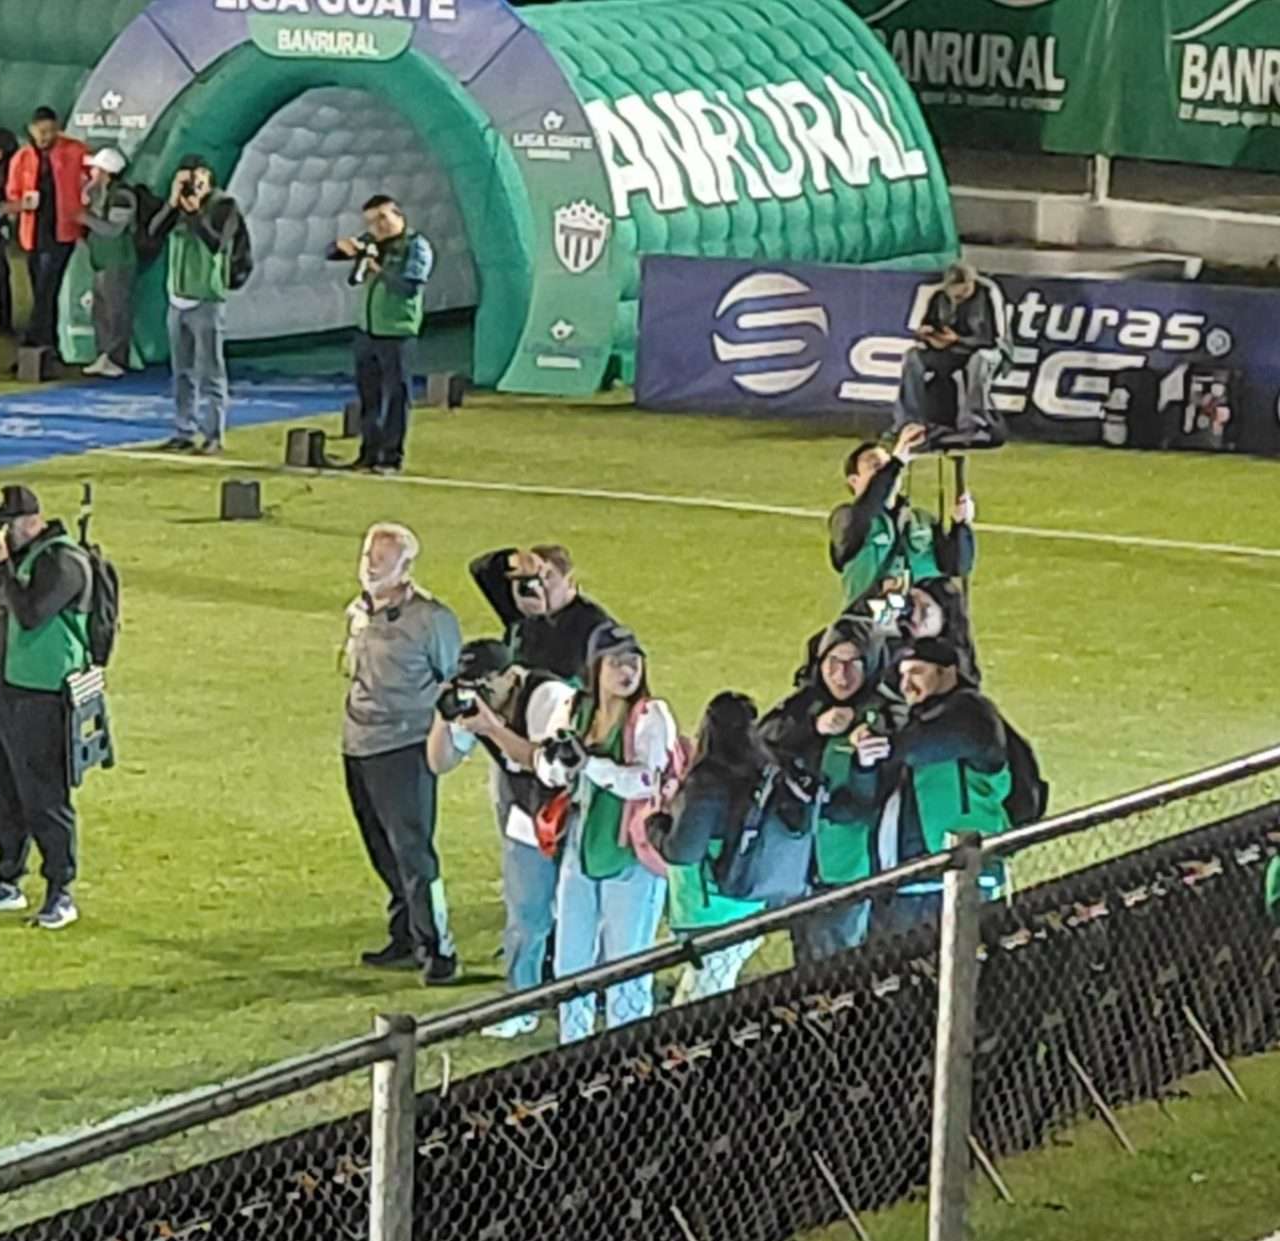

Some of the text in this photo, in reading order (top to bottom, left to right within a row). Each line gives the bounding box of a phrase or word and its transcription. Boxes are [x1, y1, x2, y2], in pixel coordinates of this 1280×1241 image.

[277, 29, 380, 55] BANRURAL
[873, 28, 1066, 92] ANRURAL
[908, 281, 1206, 352] turas
